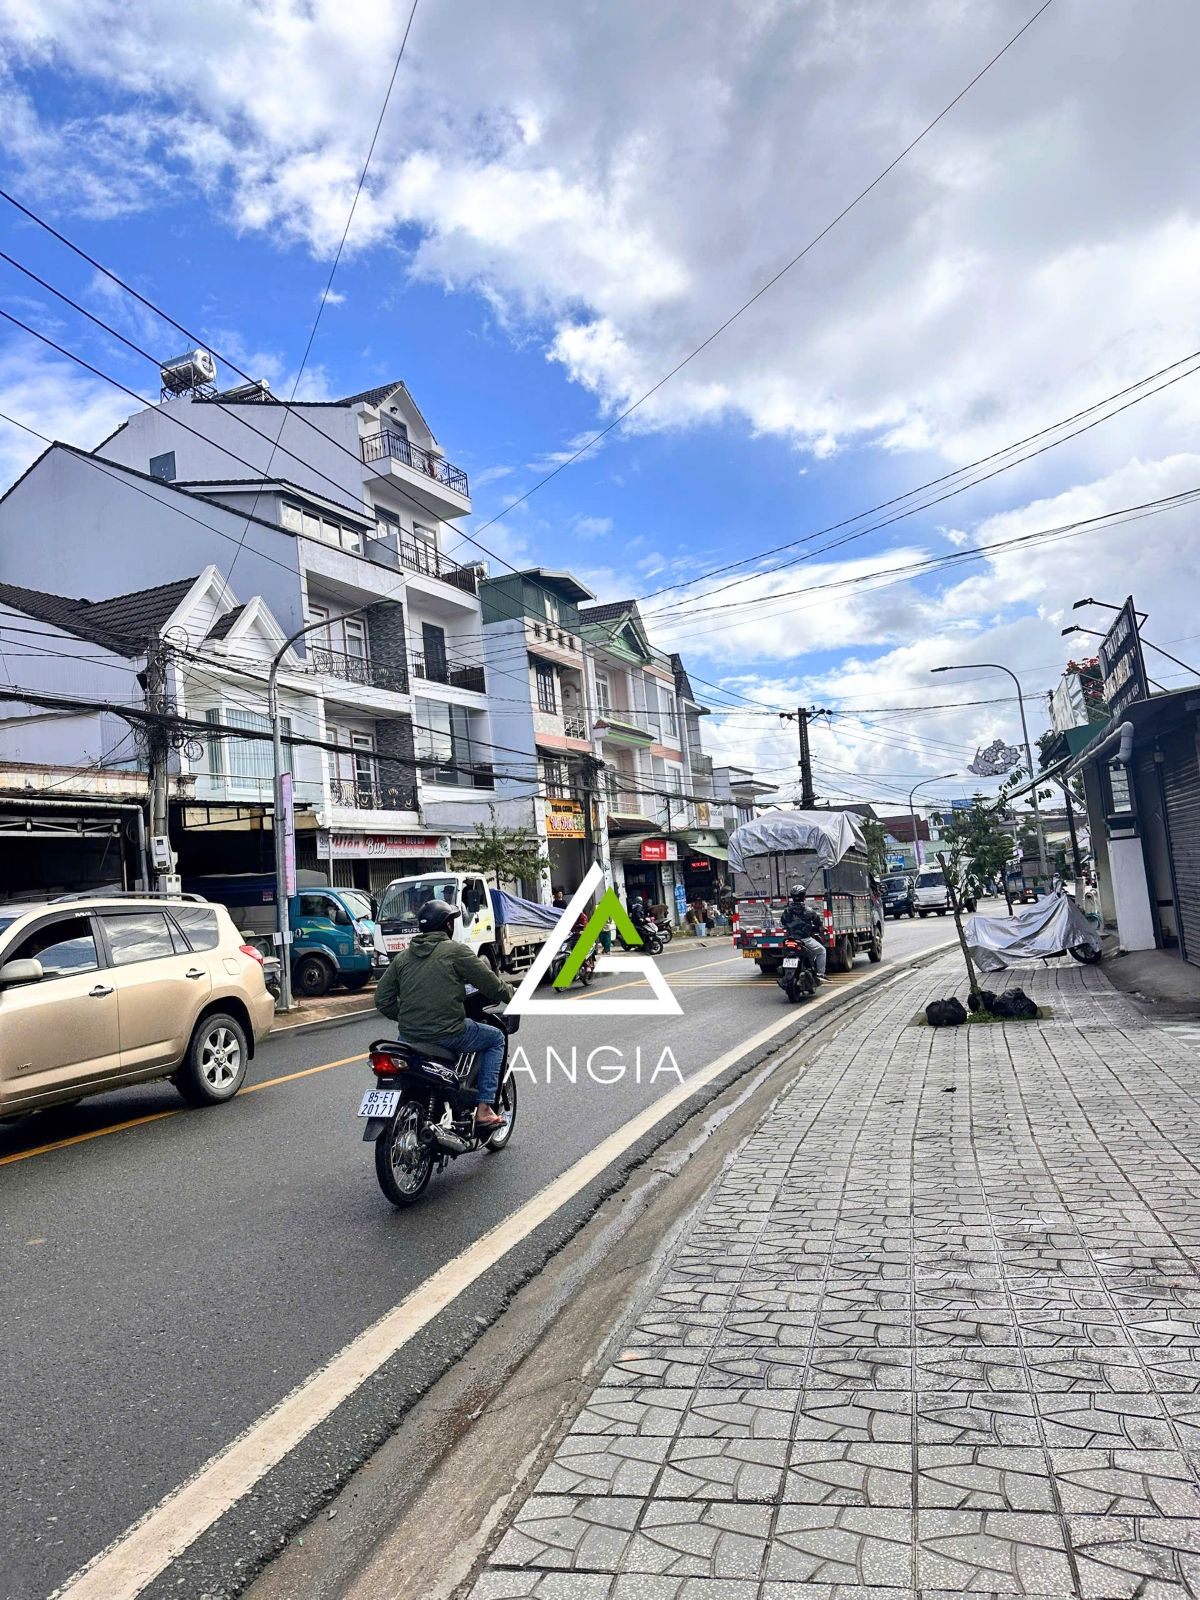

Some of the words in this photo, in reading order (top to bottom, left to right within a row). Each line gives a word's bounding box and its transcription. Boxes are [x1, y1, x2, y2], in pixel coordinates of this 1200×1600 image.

[367, 838, 387, 855] Bún
[367, 1091, 395, 1104] 85-E1
[361, 1104, 393, 1116] 201.71
